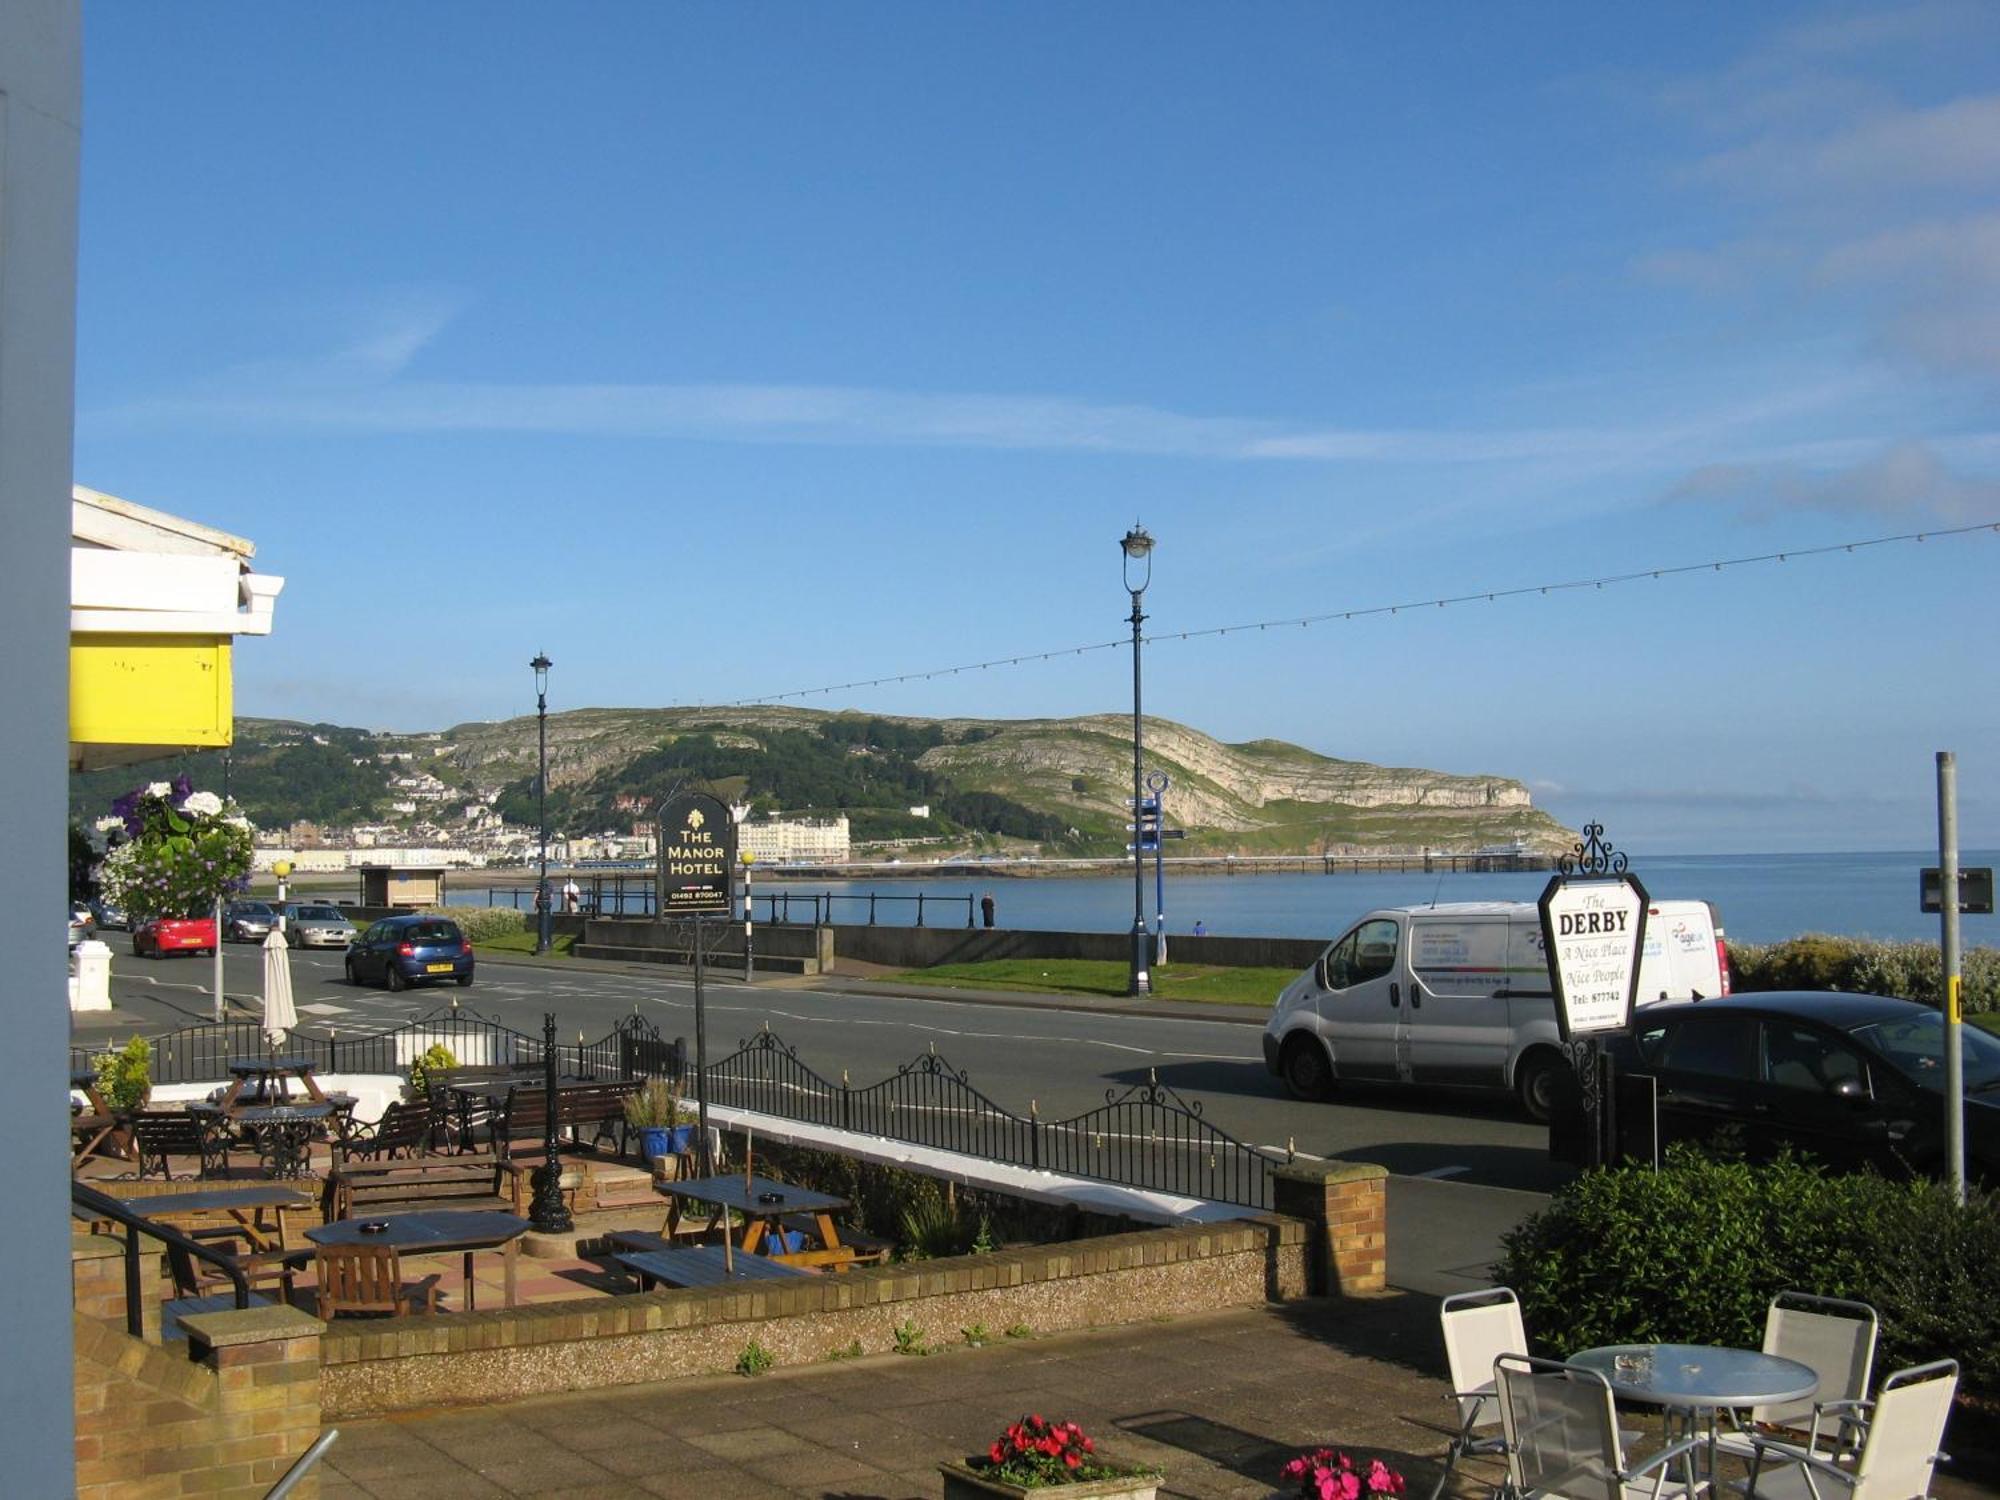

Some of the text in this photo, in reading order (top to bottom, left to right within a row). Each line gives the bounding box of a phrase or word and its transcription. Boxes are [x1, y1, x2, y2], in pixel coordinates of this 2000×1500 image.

[680, 830, 712, 843] THE
[668, 846, 724, 860] MANOR
[671, 862, 723, 875] HOTEL
[1583, 894, 1605, 908] The
[1559, 910, 1628, 936] DERBY
[1562, 943, 1627, 961] A Nice Place
[1566, 967, 1624, 988] Nice People
